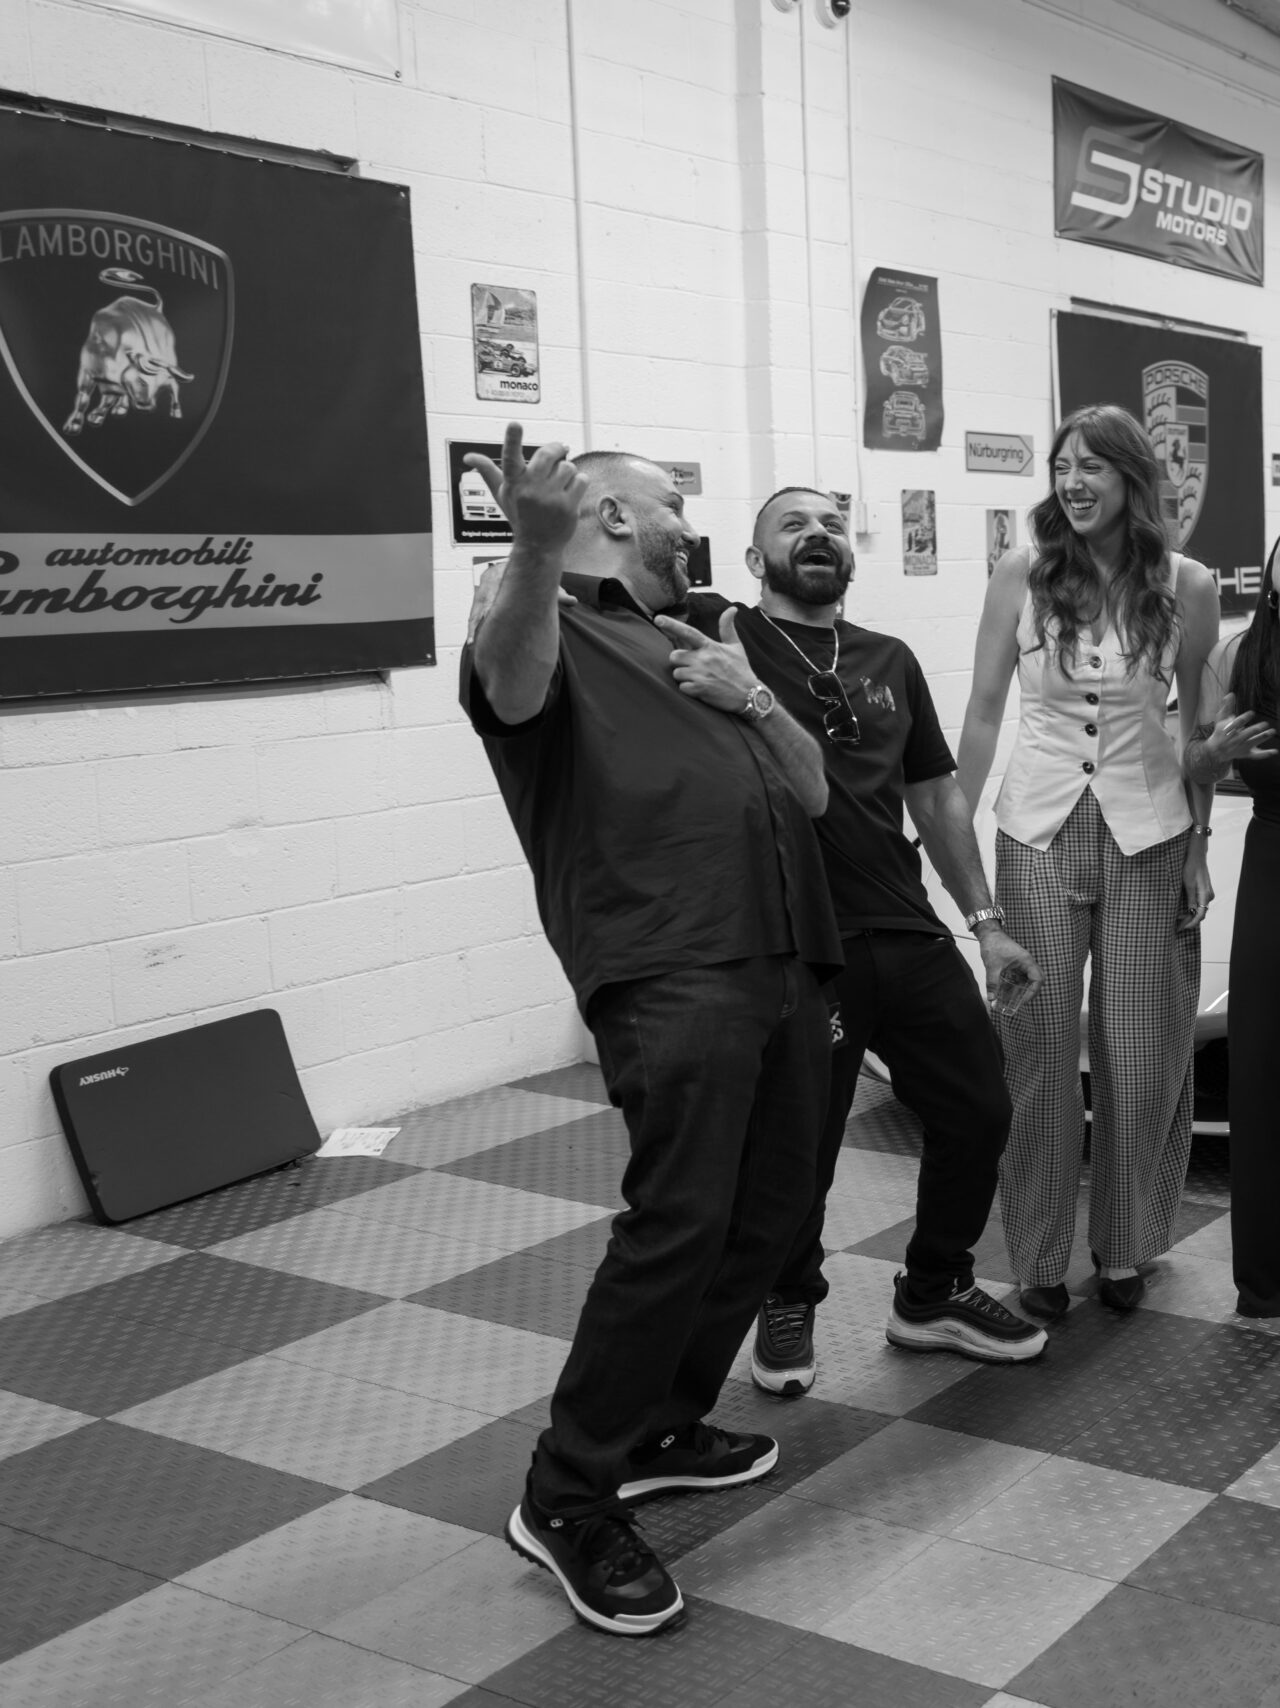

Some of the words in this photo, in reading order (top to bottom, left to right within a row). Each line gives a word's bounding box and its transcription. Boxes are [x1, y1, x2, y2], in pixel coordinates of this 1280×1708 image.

[1141, 168, 1253, 231] STUDIO
[1156, 211, 1228, 246] MOTORS
[0, 224, 218, 290] LAMBORGHINI
[500, 380, 539, 391] monaco
[1146, 368, 1207, 397] PORSCHE
[45, 537, 253, 567] automobili
[0, 551, 323, 624] mborghini
[79, 1069, 117, 1086] HUSKY
